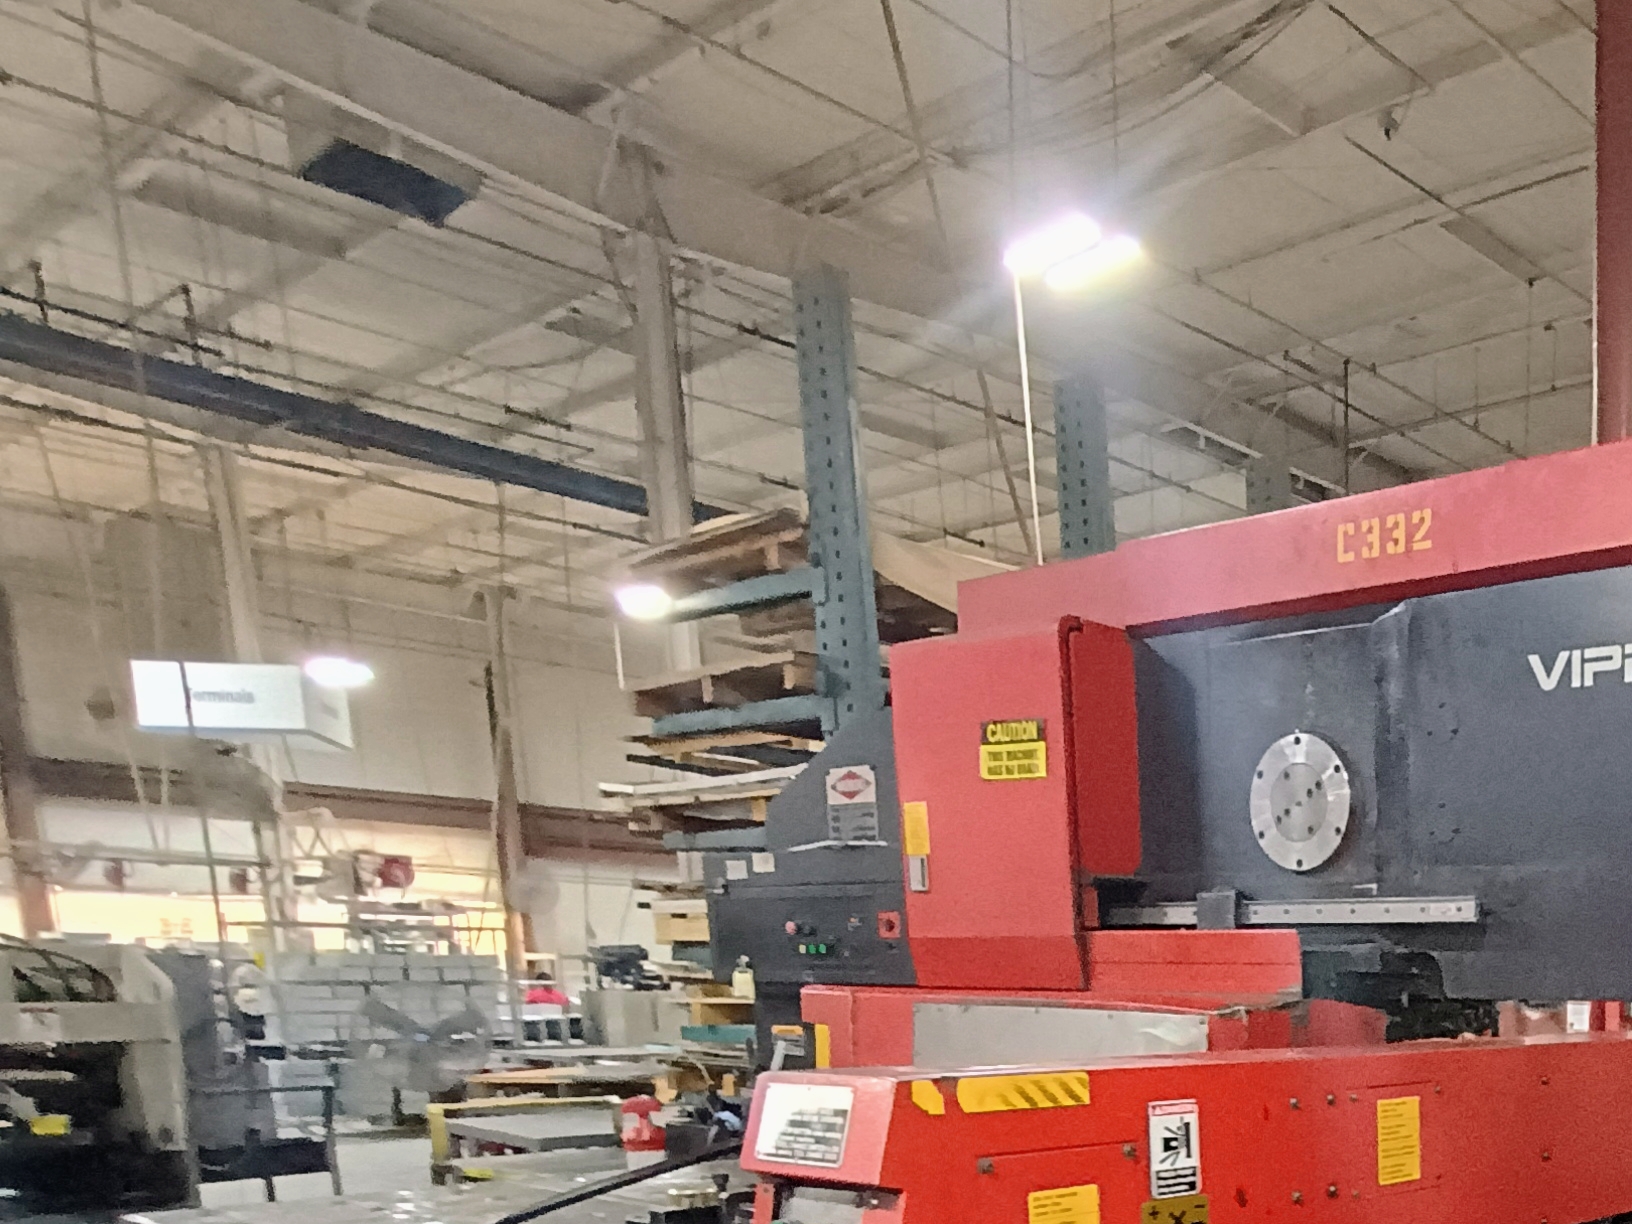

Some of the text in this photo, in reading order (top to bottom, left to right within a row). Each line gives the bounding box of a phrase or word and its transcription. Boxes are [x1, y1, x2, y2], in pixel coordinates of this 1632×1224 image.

[1336, 507, 1433, 564] C332
[186, 687, 256, 704] erminals
[986, 720, 1038, 743] CAUTION
